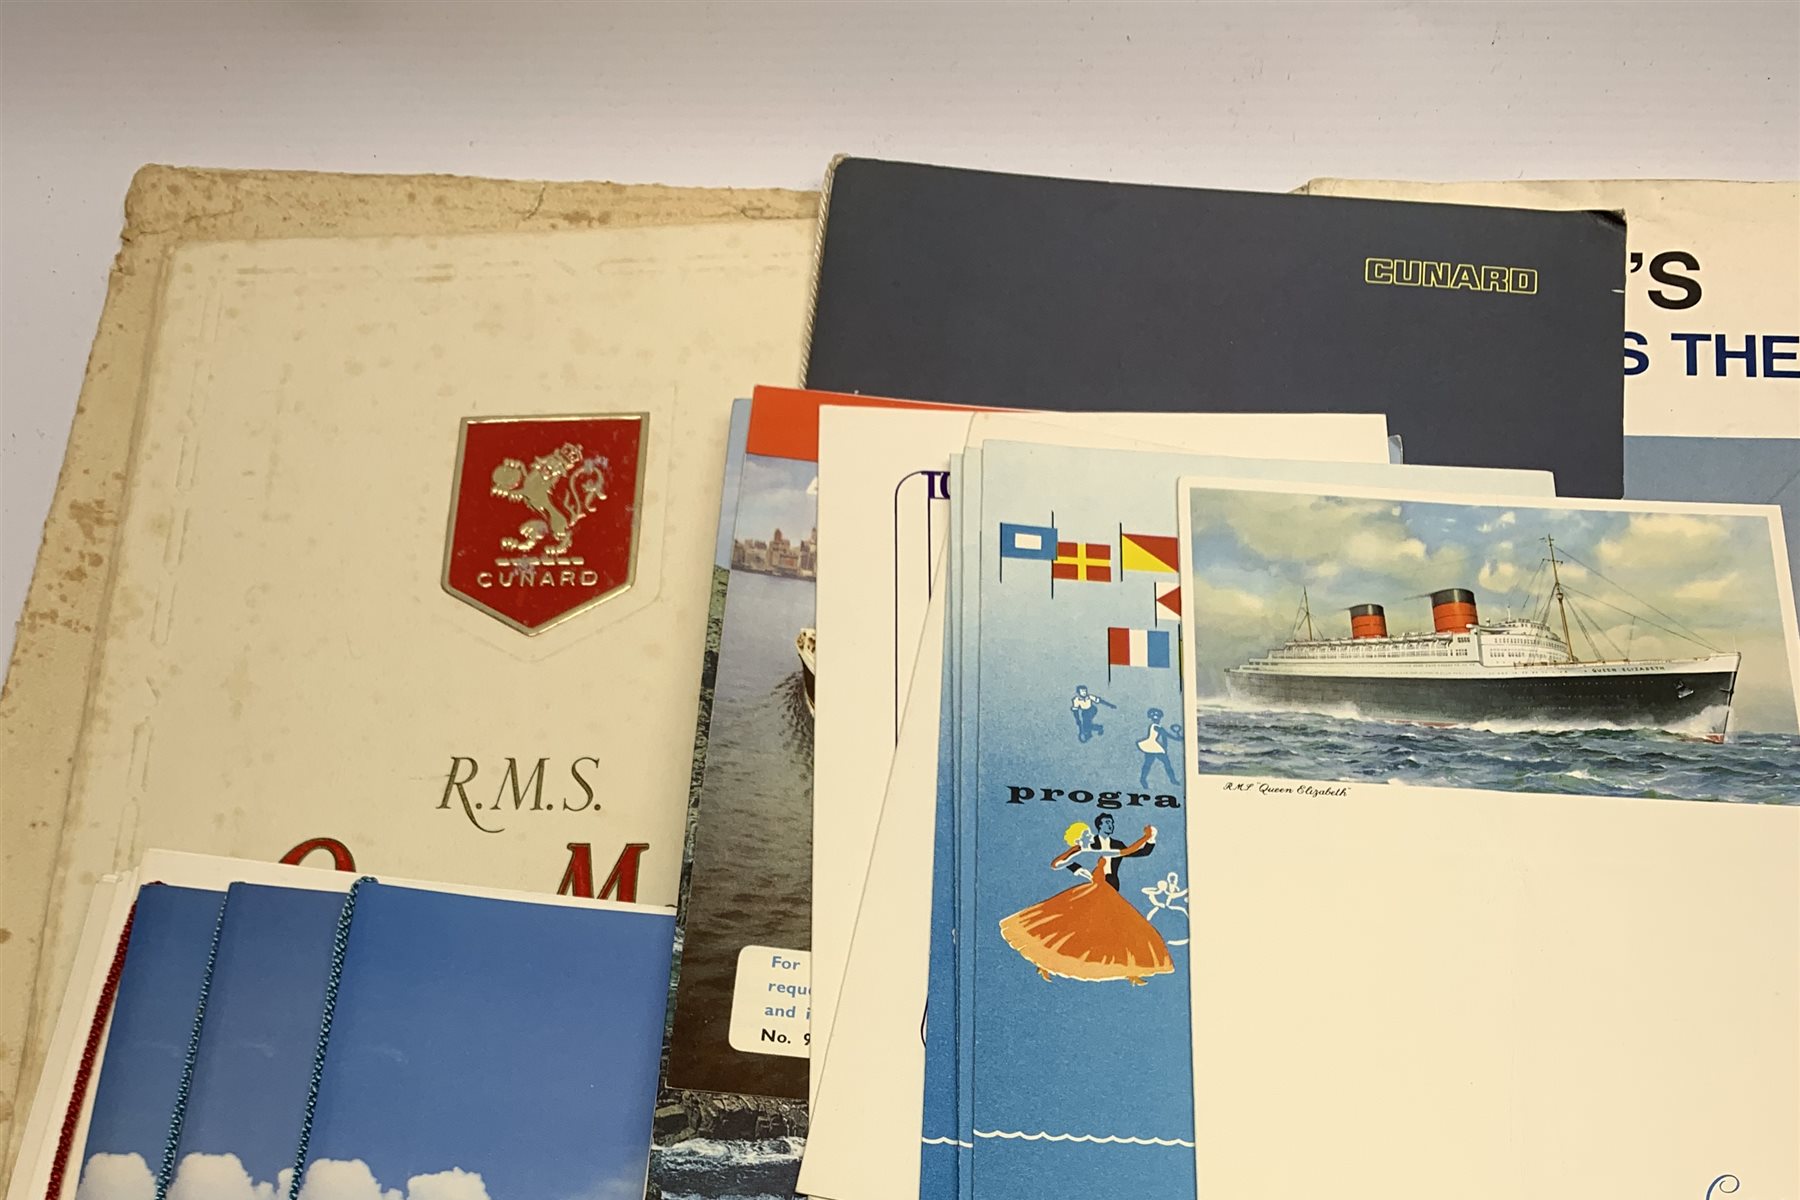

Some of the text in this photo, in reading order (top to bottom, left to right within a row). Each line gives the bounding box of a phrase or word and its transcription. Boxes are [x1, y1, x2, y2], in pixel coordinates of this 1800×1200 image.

[1364, 257, 1538, 295] CUNARD
[1670, 332, 1800, 378] THE
[476, 570, 599, 589] CUNARD
[435, 756, 602, 834] R.M.S.
[1007, 785, 1181, 810] progra
[771, 955, 801, 970] For
[768, 982, 811, 998] requ
[764, 1005, 796, 1019] and
[761, 1028, 791, 1044] No.
